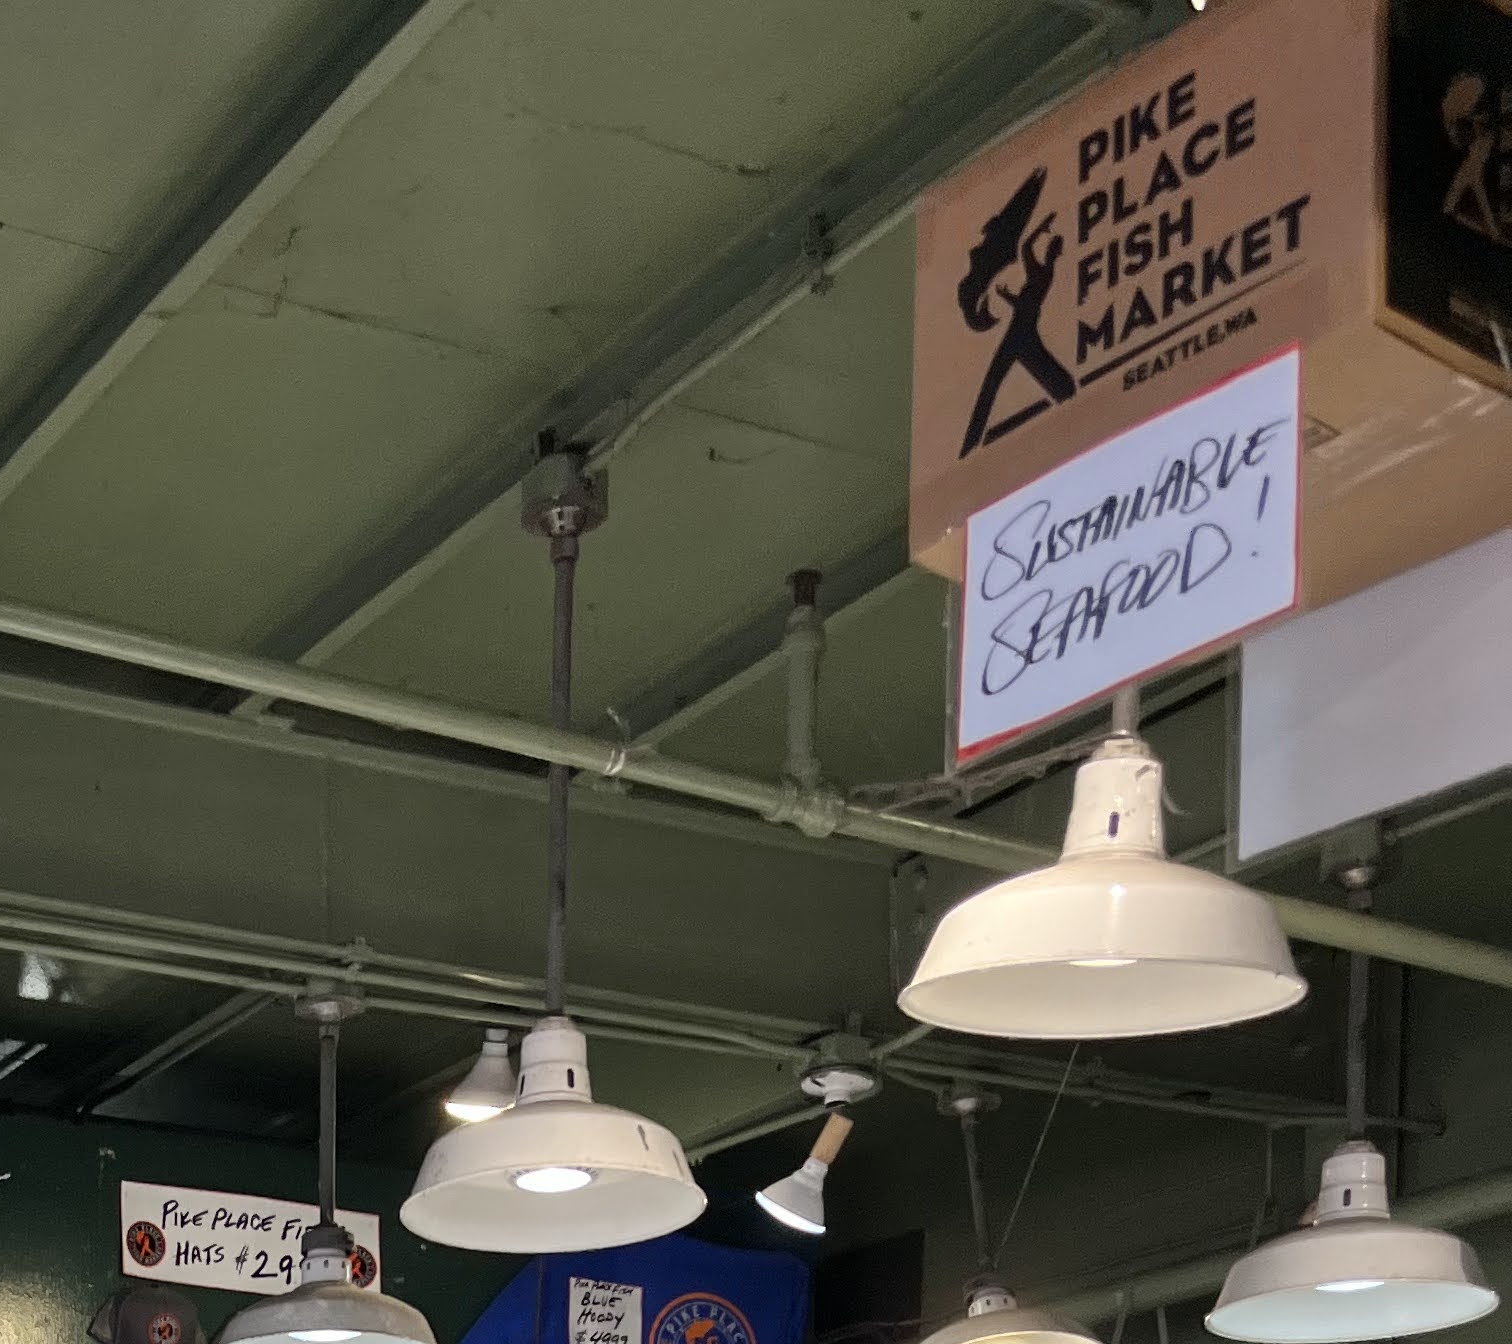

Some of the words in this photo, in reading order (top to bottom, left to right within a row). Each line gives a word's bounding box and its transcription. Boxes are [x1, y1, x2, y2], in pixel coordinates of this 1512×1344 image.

[1079, 69, 1196, 184] PIKE
[1078, 98, 1256, 244] PLACE
[1076, 191, 1311, 366] MARKET
[1077, 197, 1194, 307] FISH
[981, 418, 1288, 601] SUSTAINABLE
[161, 1199, 209, 1231] PIKE
[211, 1207, 277, 1233] PLACE
[174, 1239, 225, 1267] HATS
[576, 1307, 625, 1331] HOODY
[580, 1291, 623, 1308] BLUE
[666, 1304, 701, 1335] PIKE
